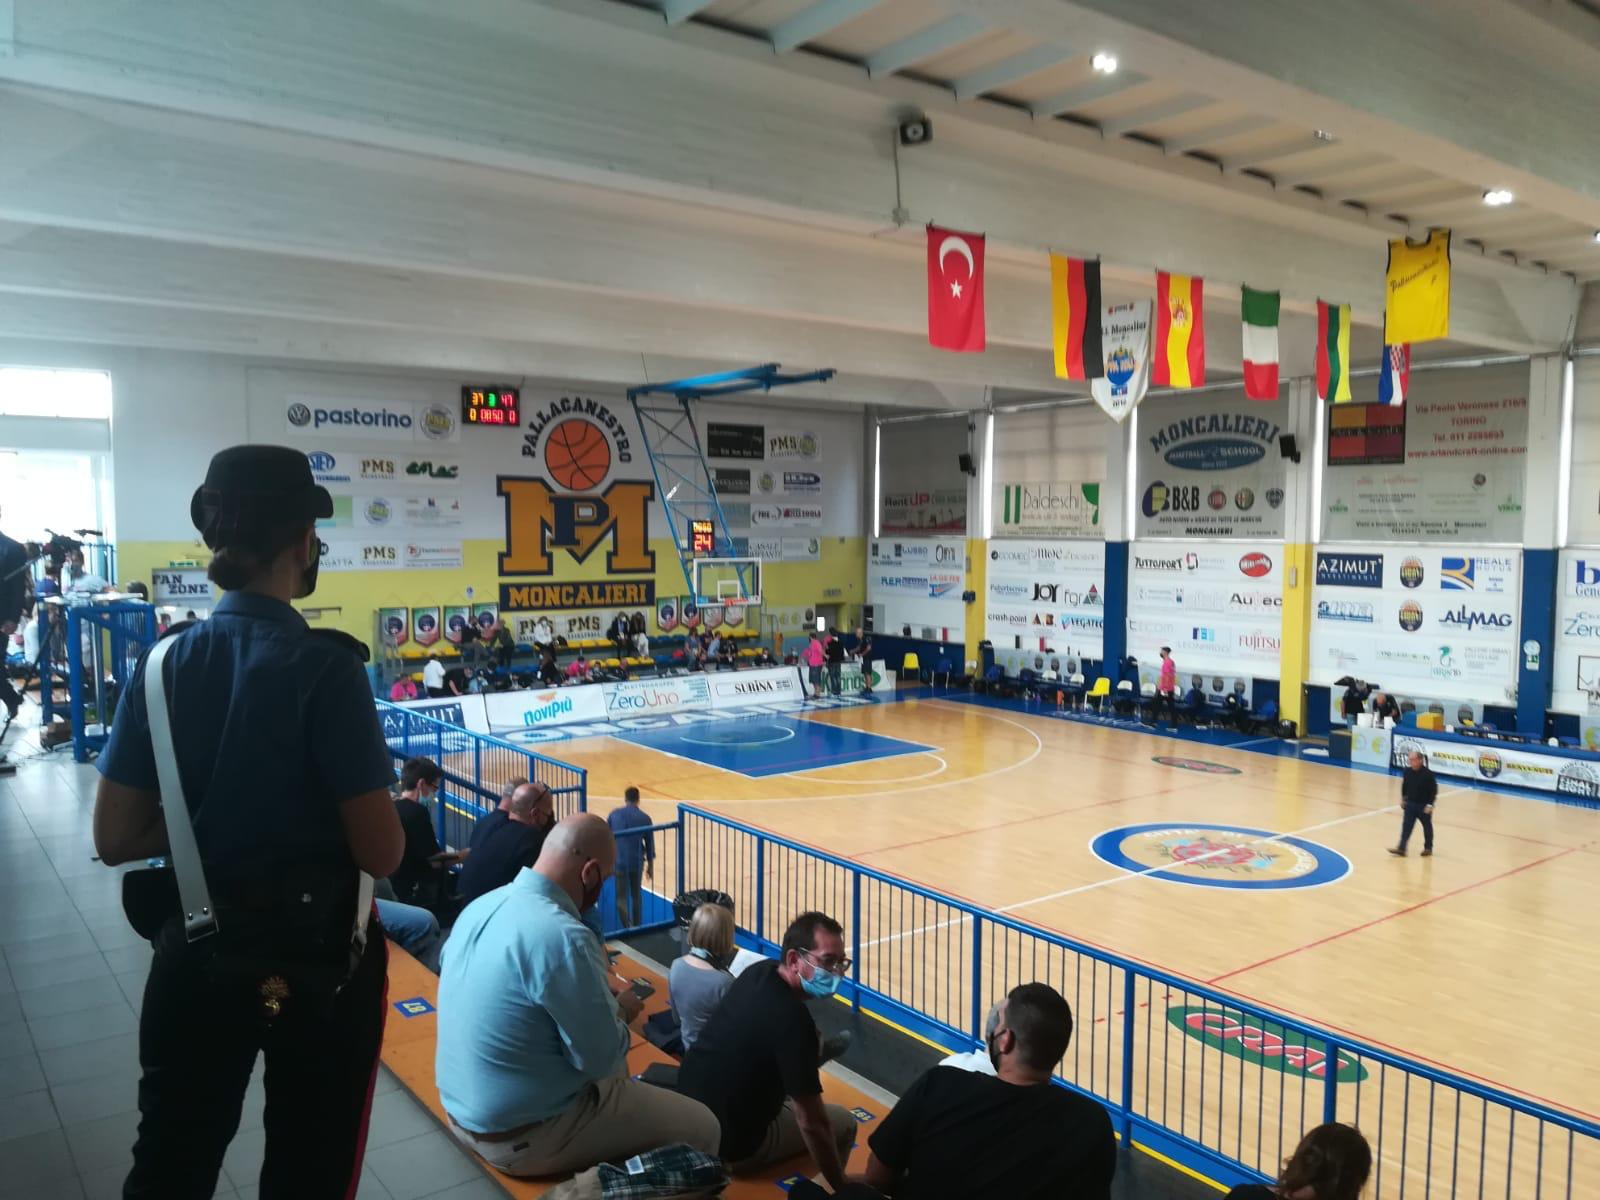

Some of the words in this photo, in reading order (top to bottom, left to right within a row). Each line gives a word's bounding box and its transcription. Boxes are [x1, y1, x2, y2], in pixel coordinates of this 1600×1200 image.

[488, 393, 496, 408] 3
[501, 394, 513, 408] 47
[314, 408, 412, 428] pastorino
[1451, 416, 1487, 426] TORINO
[522, 397, 632, 463] PALLACANESTRO
[1149, 413, 1281, 453] MONCALIERI
[361, 459, 395, 474] PMS
[1172, 485, 1200, 512] B&B
[1185, 527, 1233, 535] MONCALIERI
[694, 534, 712, 552] 24
[363, 546, 396, 560] PMS
[1318, 558, 1378, 575] AZIMUT
[152, 574, 182, 585] FAN
[168, 583, 208, 594] ZONE
[508, 583, 647, 608] MONCALIERI
[568, 616, 600, 631] PMS
[1239, 634, 1281, 651] FUJITSU
[821, 671, 866, 692] Knos
[605, 689, 680, 711] ZeroUno
